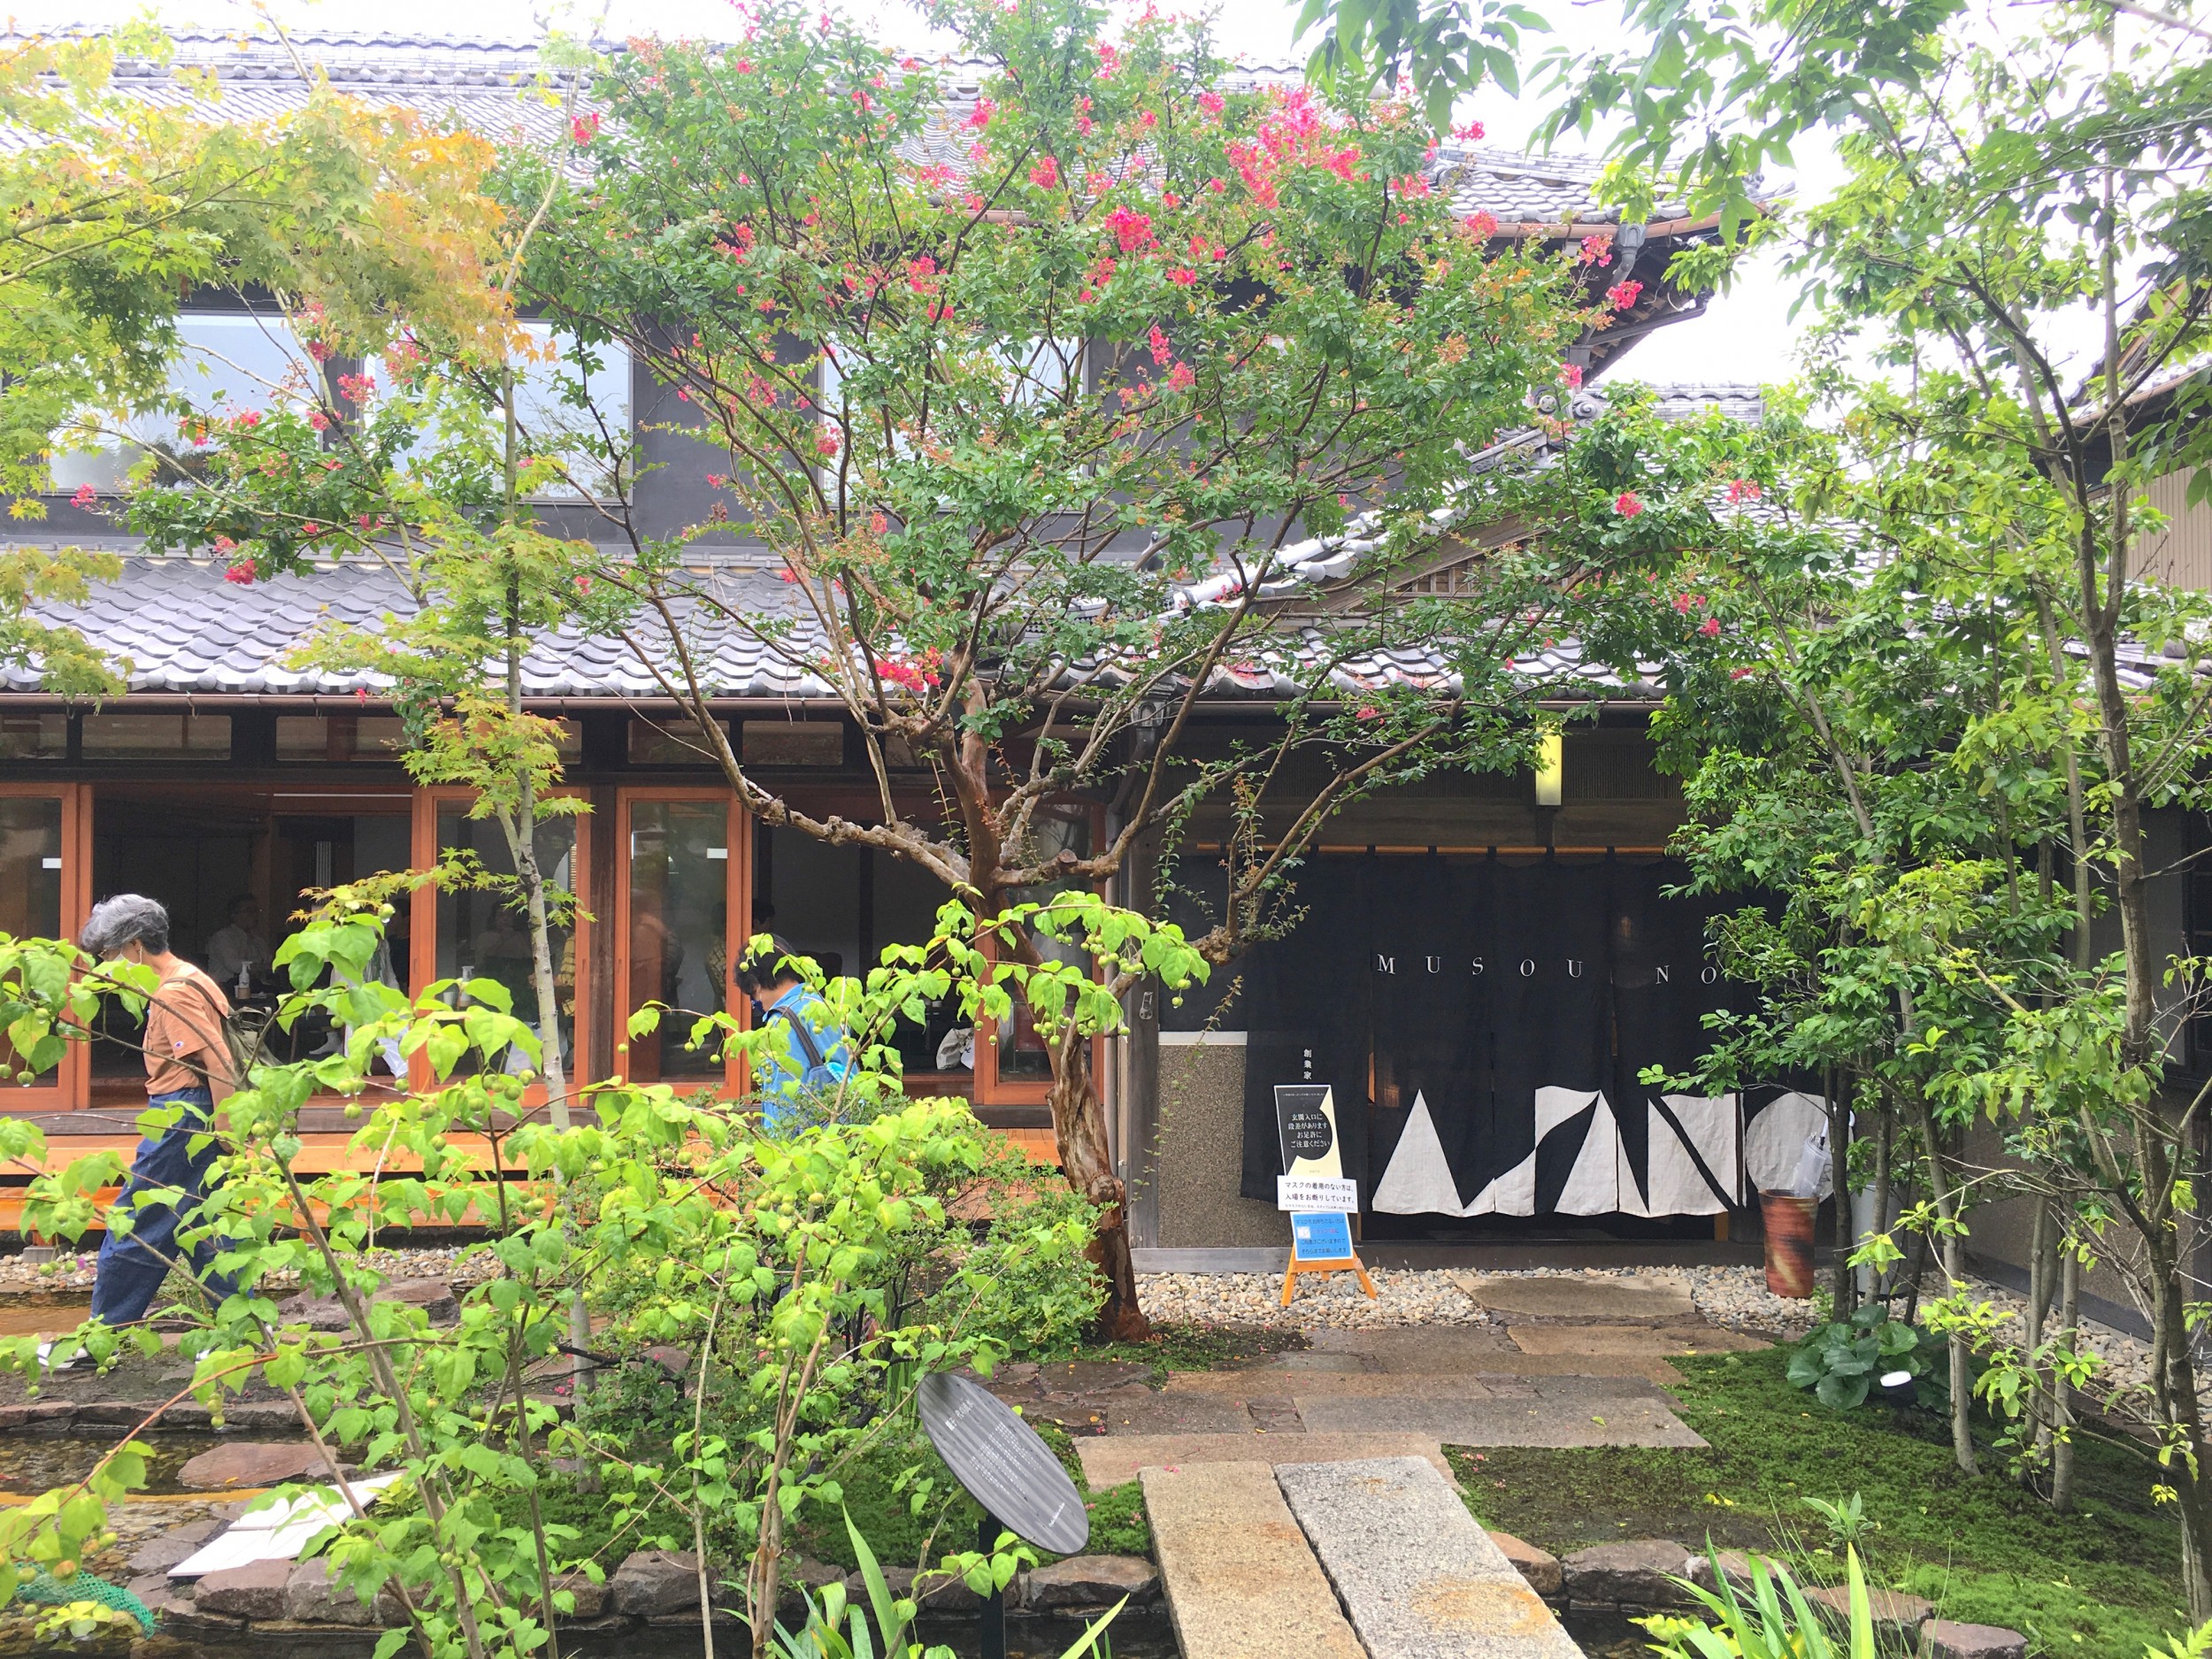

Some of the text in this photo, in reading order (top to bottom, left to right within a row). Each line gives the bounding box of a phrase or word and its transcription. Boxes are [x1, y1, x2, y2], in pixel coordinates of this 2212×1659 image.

[1378, 954, 1583, 979] MUSOU
[1292, 1113, 1324, 1122] 玄関入口に
[1288, 1122, 1328, 1131] 段差があります
[1290, 1140, 1331, 1148] ご注意ください
[1285, 1182, 1354, 1192] マスクの着用のない方は、
[1285, 1193, 1354, 1203] 入場をお断りしています。
